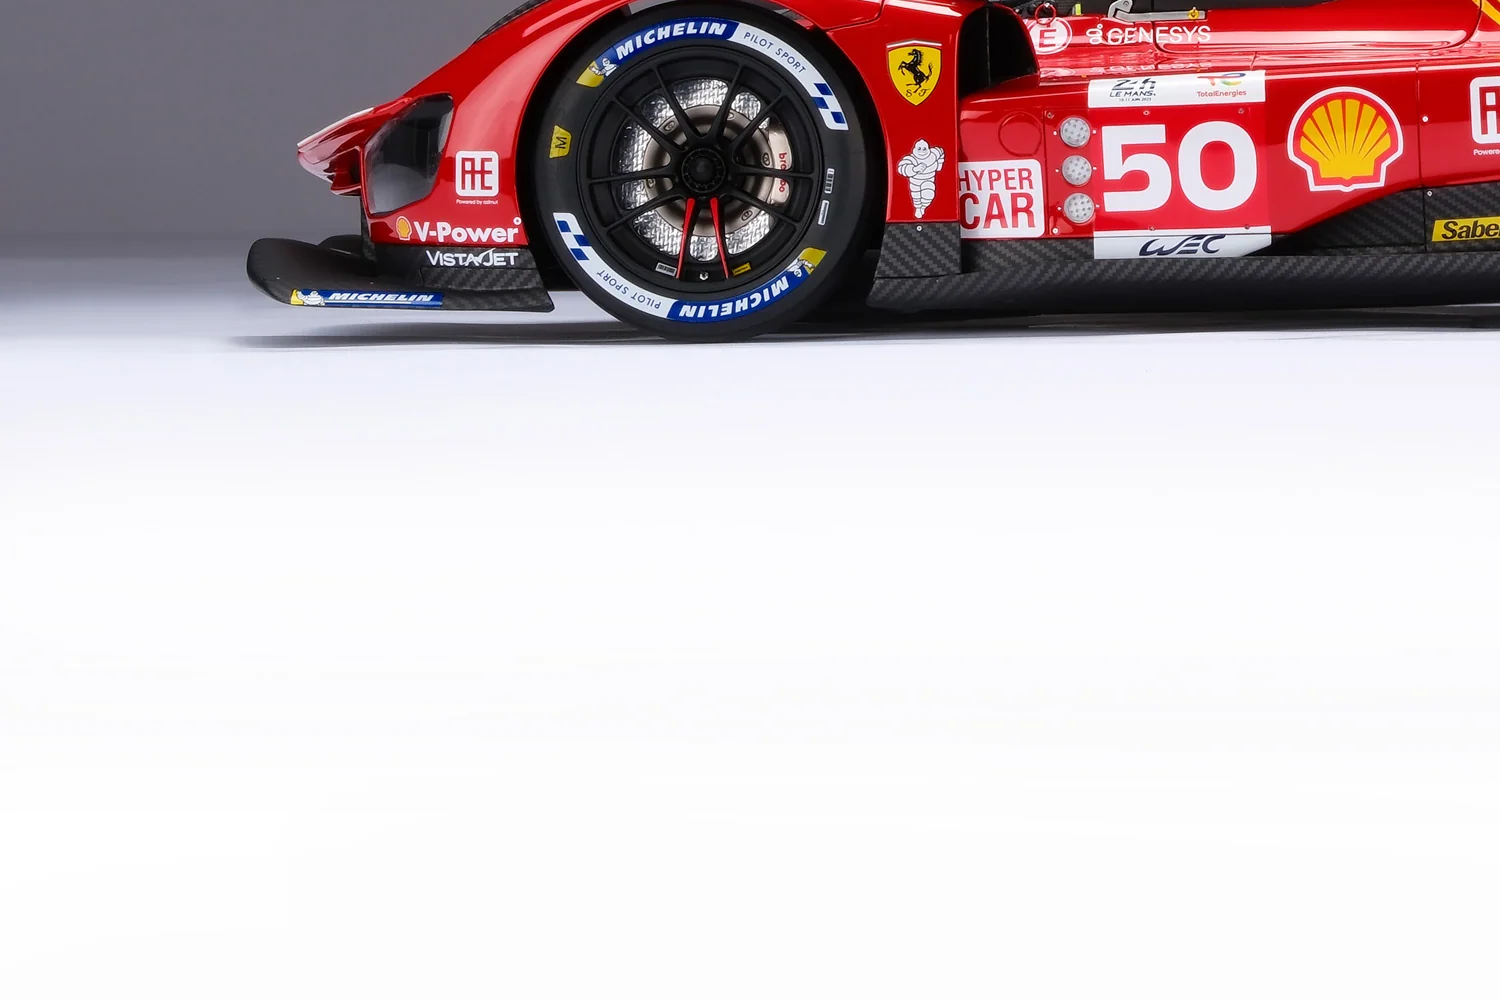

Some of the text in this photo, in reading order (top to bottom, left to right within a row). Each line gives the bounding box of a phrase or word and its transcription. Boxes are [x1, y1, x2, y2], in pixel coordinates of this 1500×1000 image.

[615, 20, 806, 74] MICHELIN PILOT SPORT
[1107, 25, 1212, 46] GENESYS
[1196, 89, 1247, 98] TotalEnergies
[554, 136, 567, 150] M
[1101, 120, 1258, 213] 50
[959, 167, 1034, 192] HYPER
[959, 192, 1036, 230] CAR
[413, 221, 519, 243] V-Power
[1138, 234, 1227, 257] WEC
[327, 292, 435, 302] MICHELIN
[595, 271, 791, 319] MICHELIN PILOT SPORT
